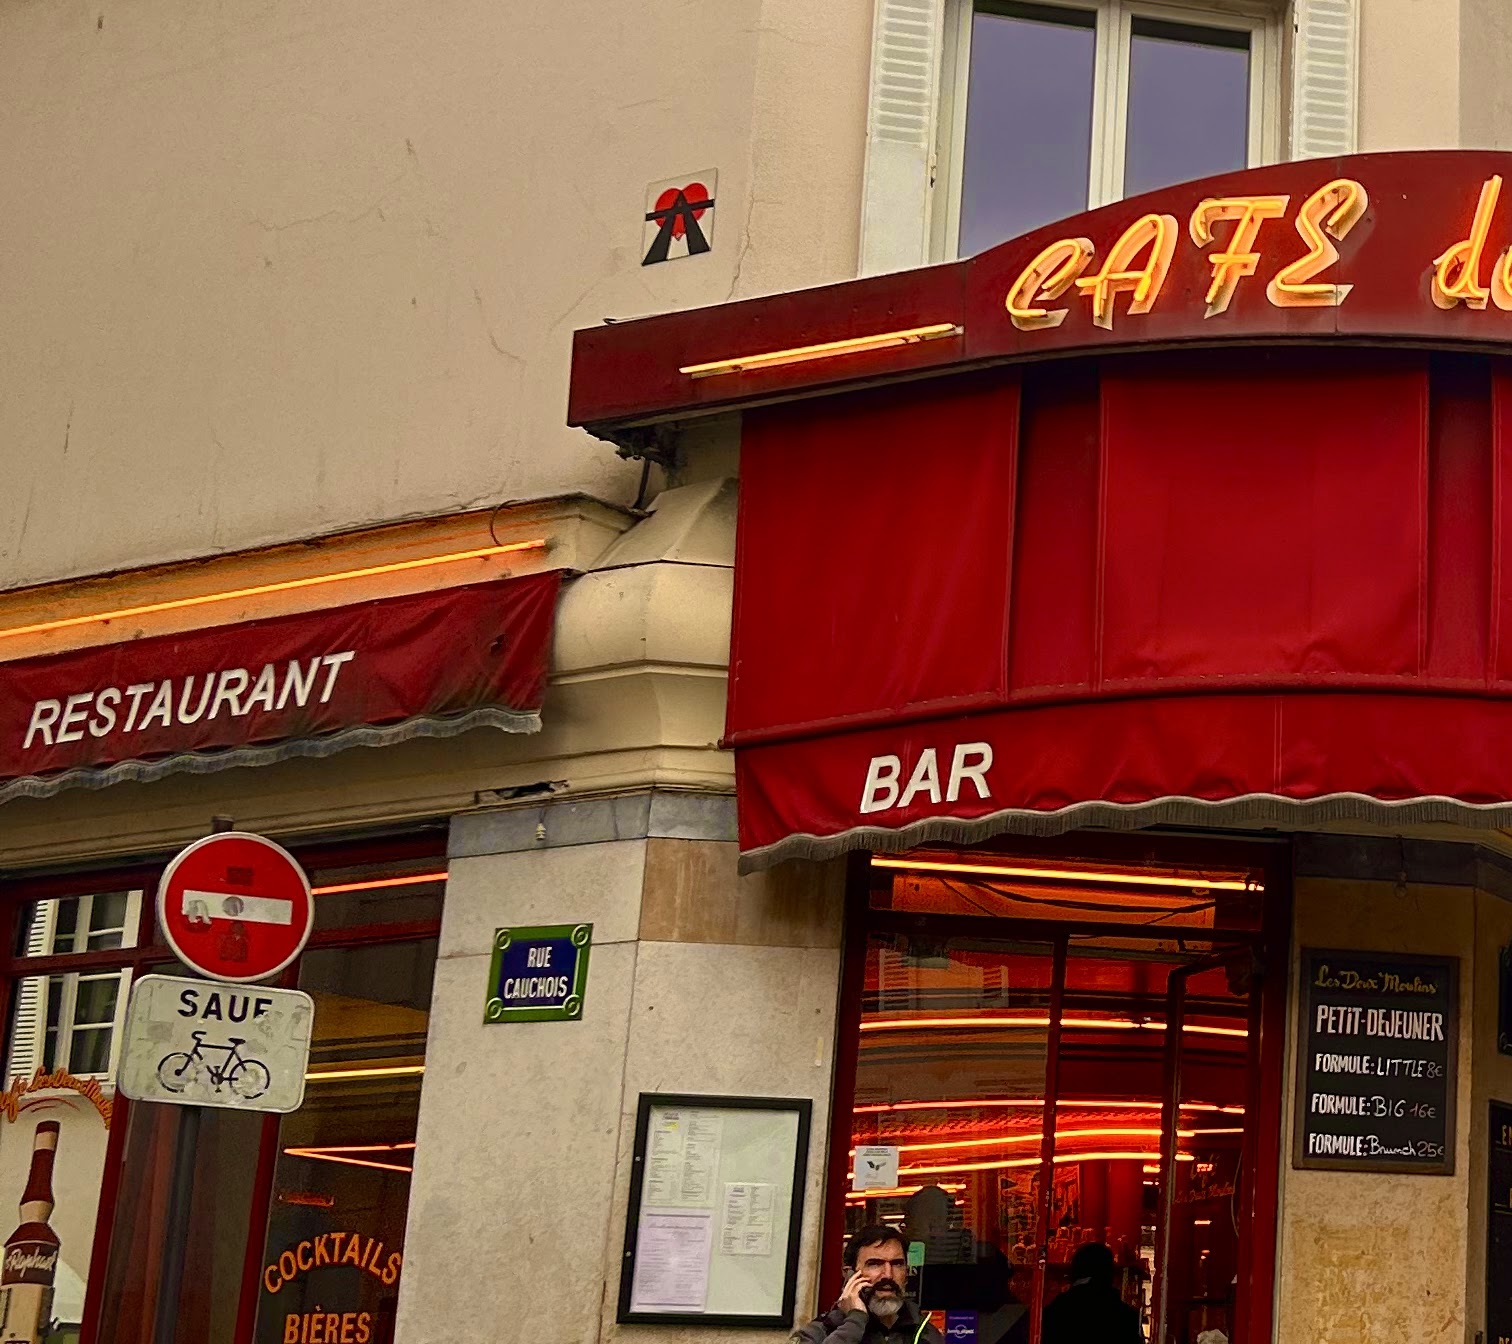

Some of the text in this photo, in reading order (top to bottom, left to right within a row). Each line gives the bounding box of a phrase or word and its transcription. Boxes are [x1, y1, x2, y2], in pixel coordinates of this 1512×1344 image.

[22, 650, 356, 749] RESTAURANT
[859, 741, 994, 814] BAR
[527, 946, 553, 968] RUE
[503, 976, 569, 999] CAUCHOIS
[177, 988, 273, 1024] SAUF
[1315, 1053, 1375, 1075] FORMULE:
[1376, 1057, 1427, 1078] LITTLE
[1311, 1093, 1437, 1118] FORMULE: BIG 16€
[1308, 1133, 1445, 1157] FORMULE: Brunch 25€
[264, 1232, 402, 1294] COCKTAILS
